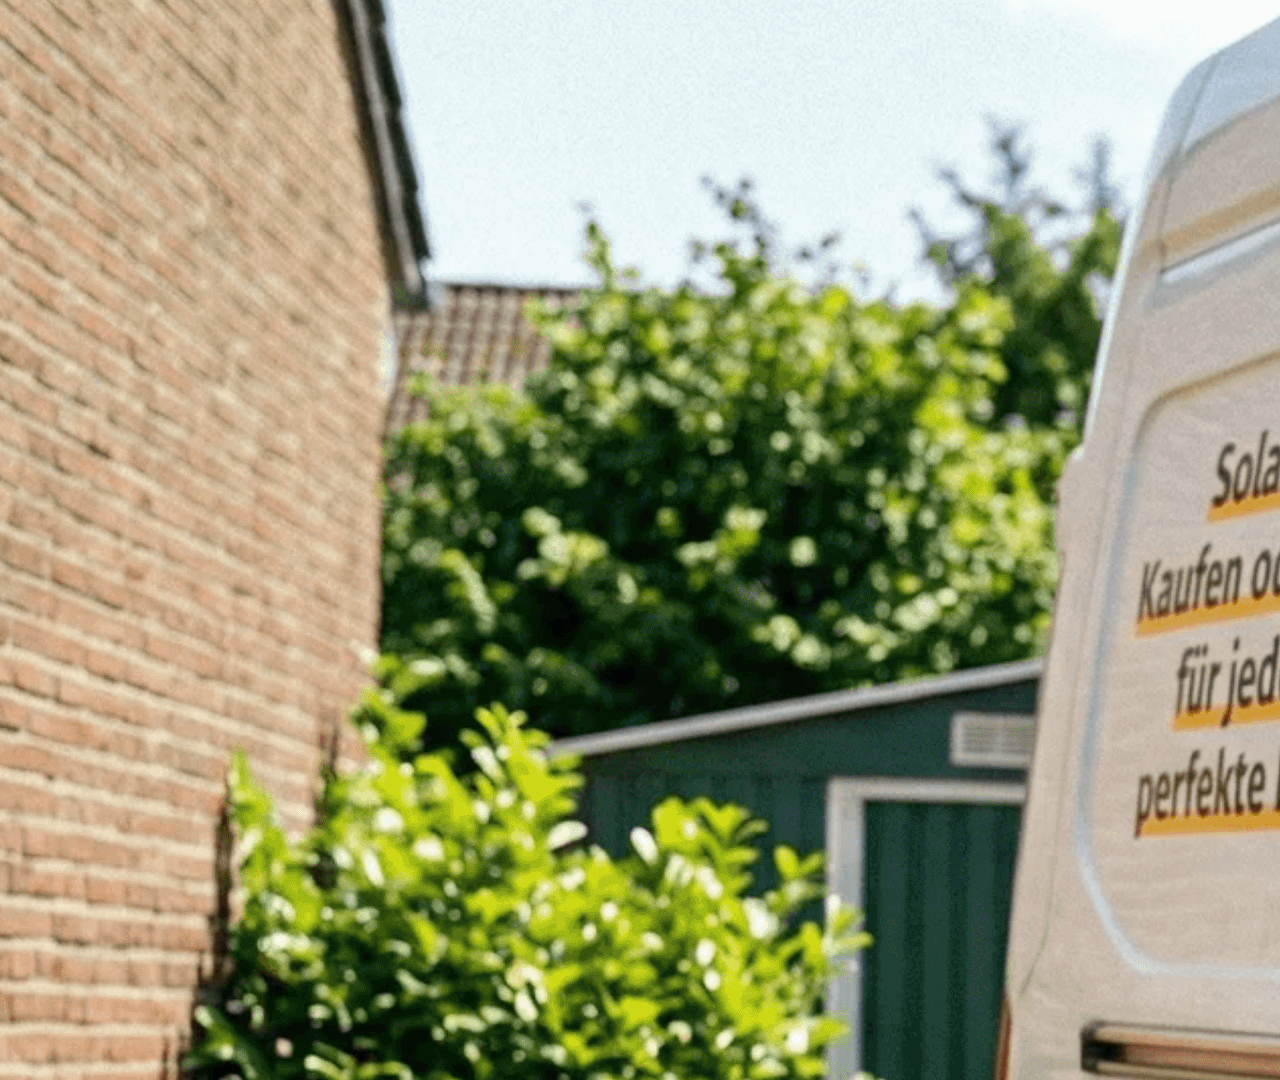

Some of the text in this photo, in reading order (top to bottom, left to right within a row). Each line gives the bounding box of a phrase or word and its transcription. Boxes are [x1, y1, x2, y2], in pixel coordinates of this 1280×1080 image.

[1138, 545, 1242, 622] Kaufen
[1175, 646, 1221, 717] für
[1135, 747, 1267, 838] perfekte
